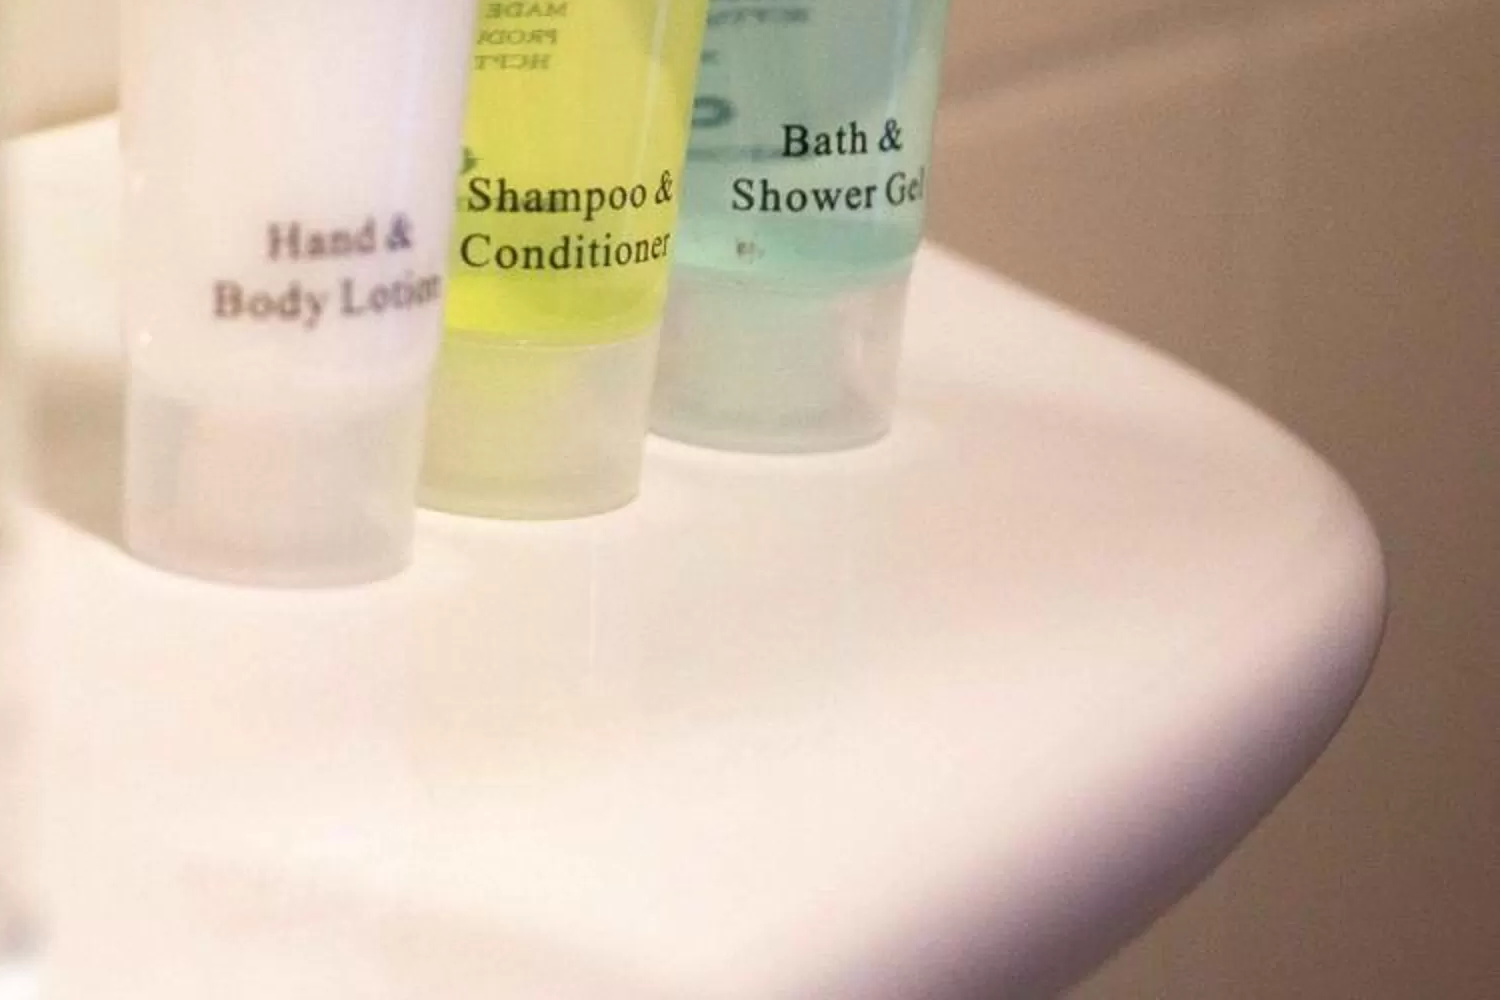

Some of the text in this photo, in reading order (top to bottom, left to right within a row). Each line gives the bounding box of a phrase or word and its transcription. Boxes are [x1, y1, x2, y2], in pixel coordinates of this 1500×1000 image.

[782, 117, 902, 157] Bath &
[467, 169, 673, 222] Shampoo &
[732, 166, 926, 212] Shower Gel
[266, 211, 412, 261] Hand &
[460, 231, 670, 271] Conditioner
[214, 278, 329, 332] Body
